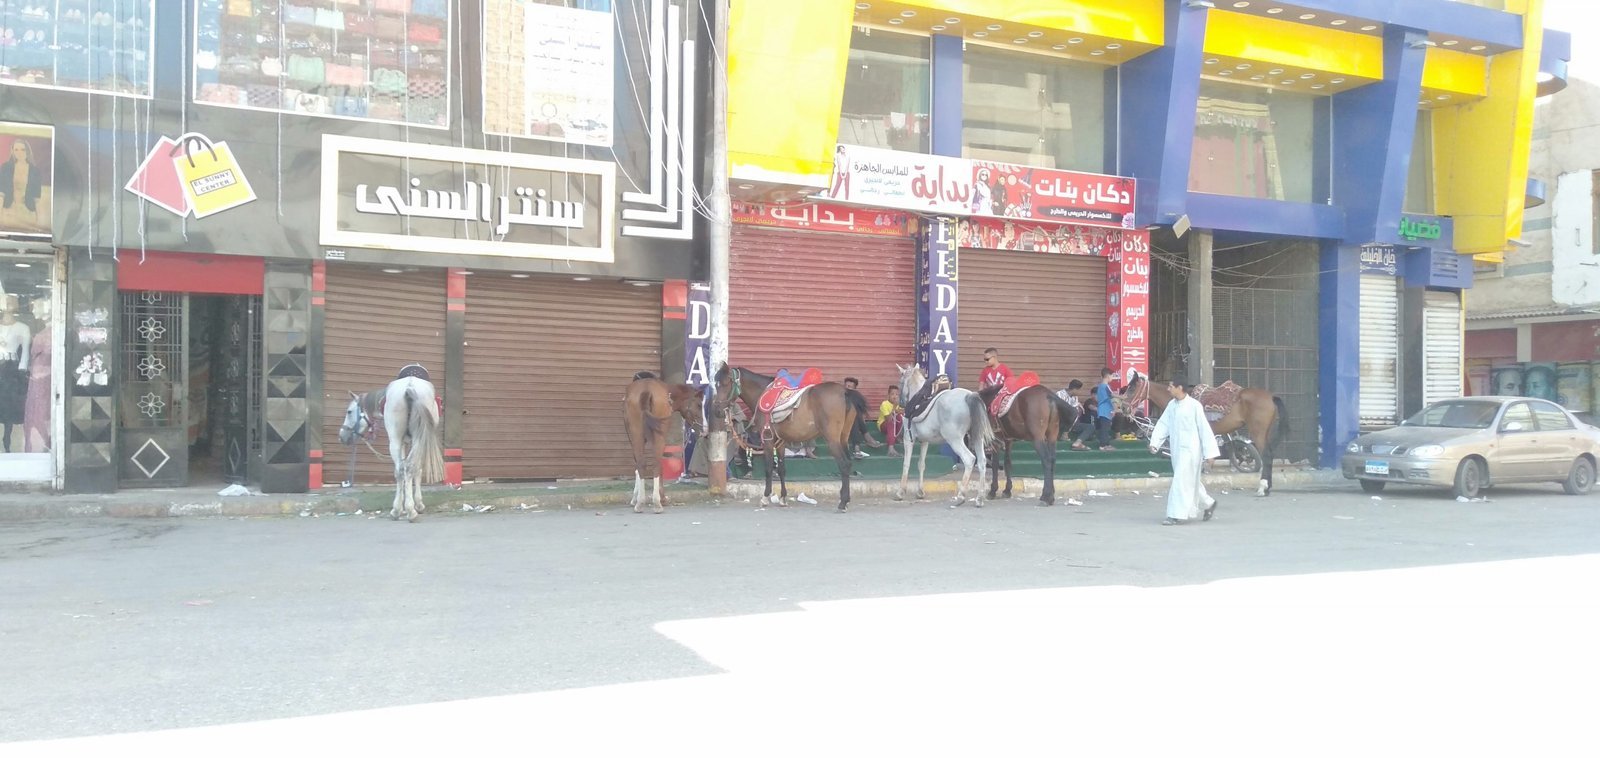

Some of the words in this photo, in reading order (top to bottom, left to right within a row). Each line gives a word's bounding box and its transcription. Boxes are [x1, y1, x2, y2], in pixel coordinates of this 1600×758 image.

[205, 172, 229, 183] SUNNY
[854, 161, 882, 174] الجاهزة
[882, 165, 909, 176] للملابس
[200, 179, 230, 192] CENTER
[911, 165, 969, 208] بداية
[1035, 178, 1078, 204] بنات
[1083, 182, 1130, 205] دكان
[496, 186, 585, 236] سنتر
[770, 199, 854, 231] بداية
[1123, 234, 1149, 253] دكان
[1123, 257, 1149, 279] بنات
